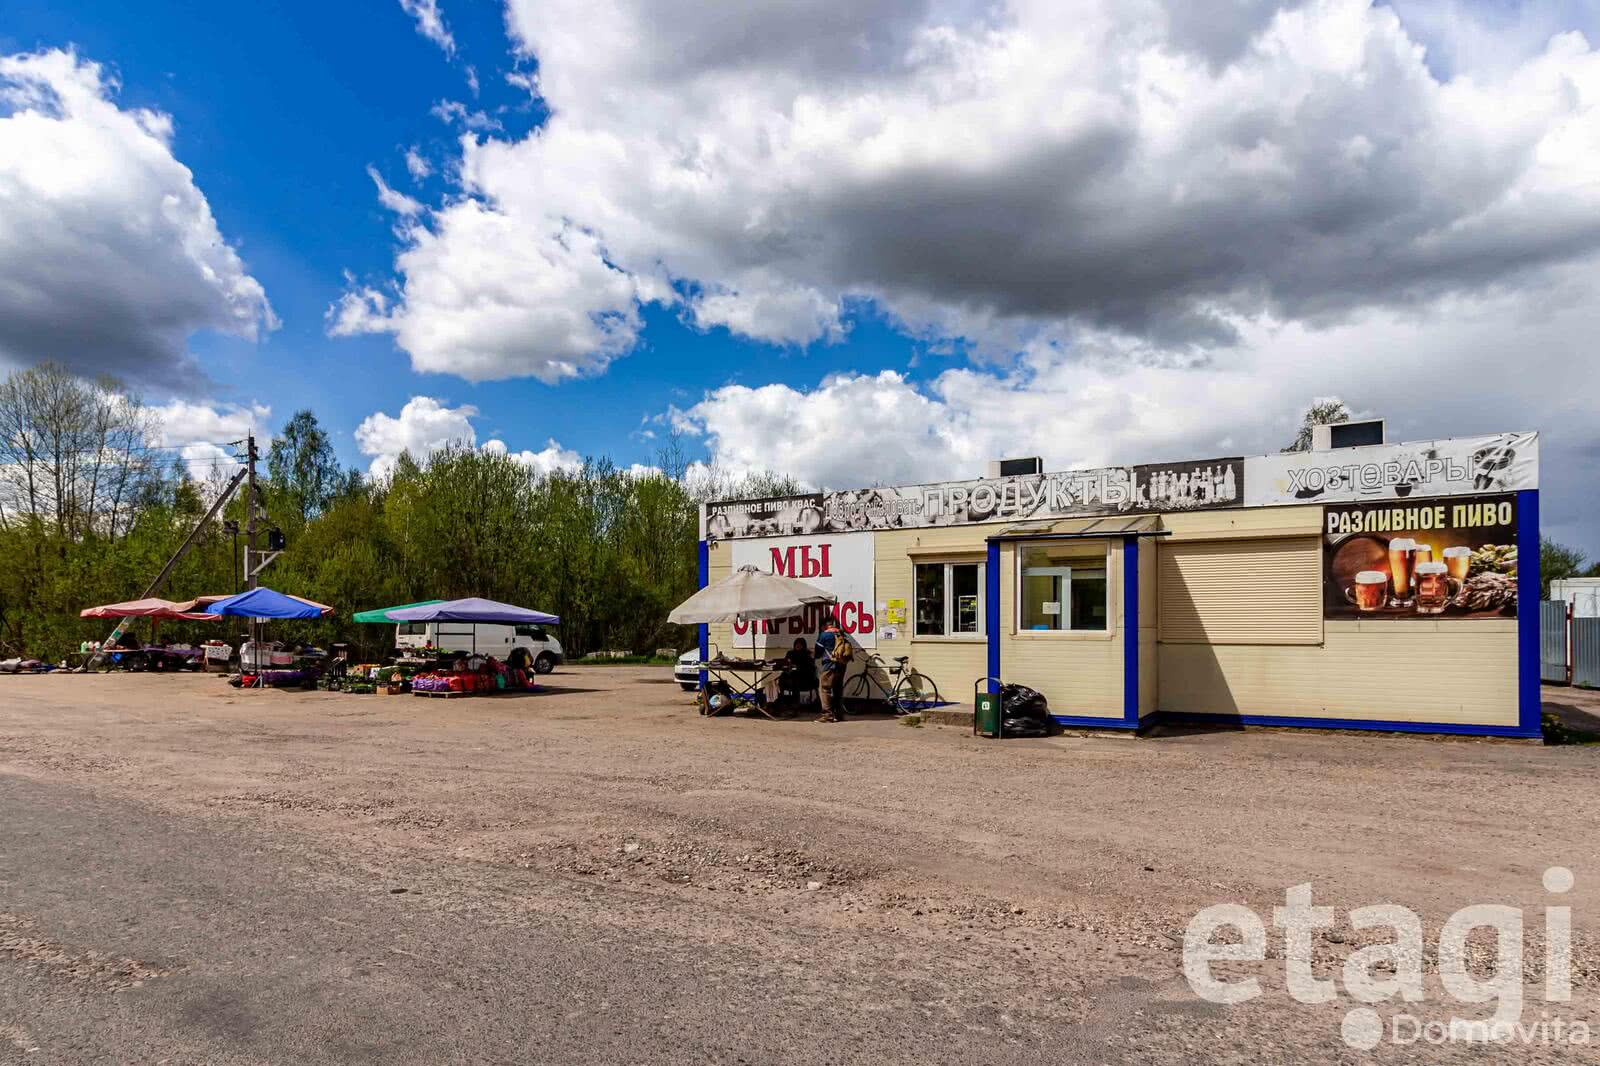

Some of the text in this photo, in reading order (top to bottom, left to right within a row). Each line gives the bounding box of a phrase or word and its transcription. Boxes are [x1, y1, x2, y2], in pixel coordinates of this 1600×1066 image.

[1287, 456, 1475, 493] ХОЗТОВАРЫ
[712, 498, 816, 515] РАЗЛИВНОЕ ПИВО КВАС
[924, 471, 1138, 517] ПРОДУКТЫ
[1327, 502, 1512, 534] РАЗЛИВНОЕ ПИВО
[769, 544, 832, 578] МЫ
